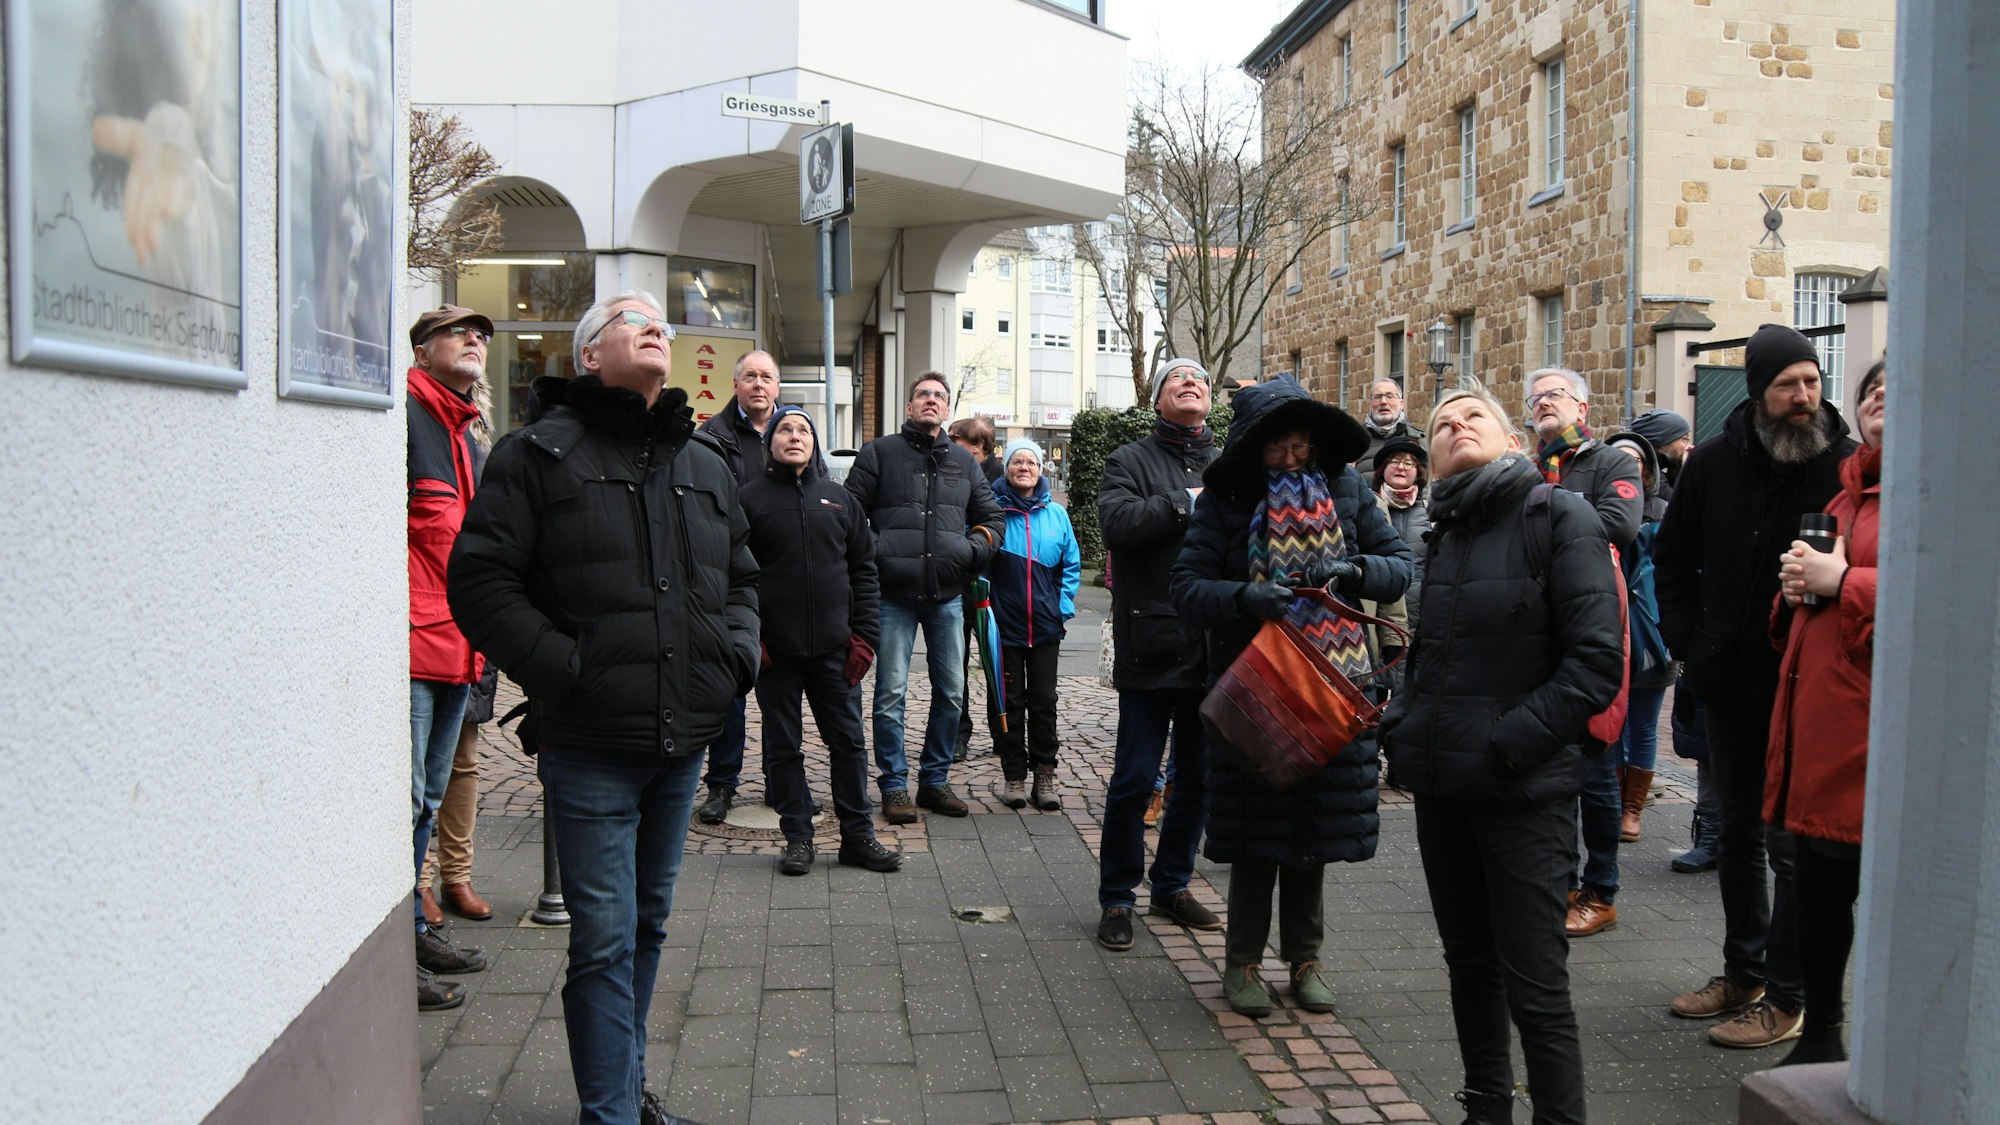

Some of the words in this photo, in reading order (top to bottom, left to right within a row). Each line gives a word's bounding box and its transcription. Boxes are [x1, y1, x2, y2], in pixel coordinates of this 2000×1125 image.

[726, 96, 816, 118] Griesgasse
[811, 194, 832, 214] ZONE
[176, 311, 240, 366] Siegburg
[291, 342, 354, 379] tadtbibliothek
[696, 344, 716, 400] ASIA
